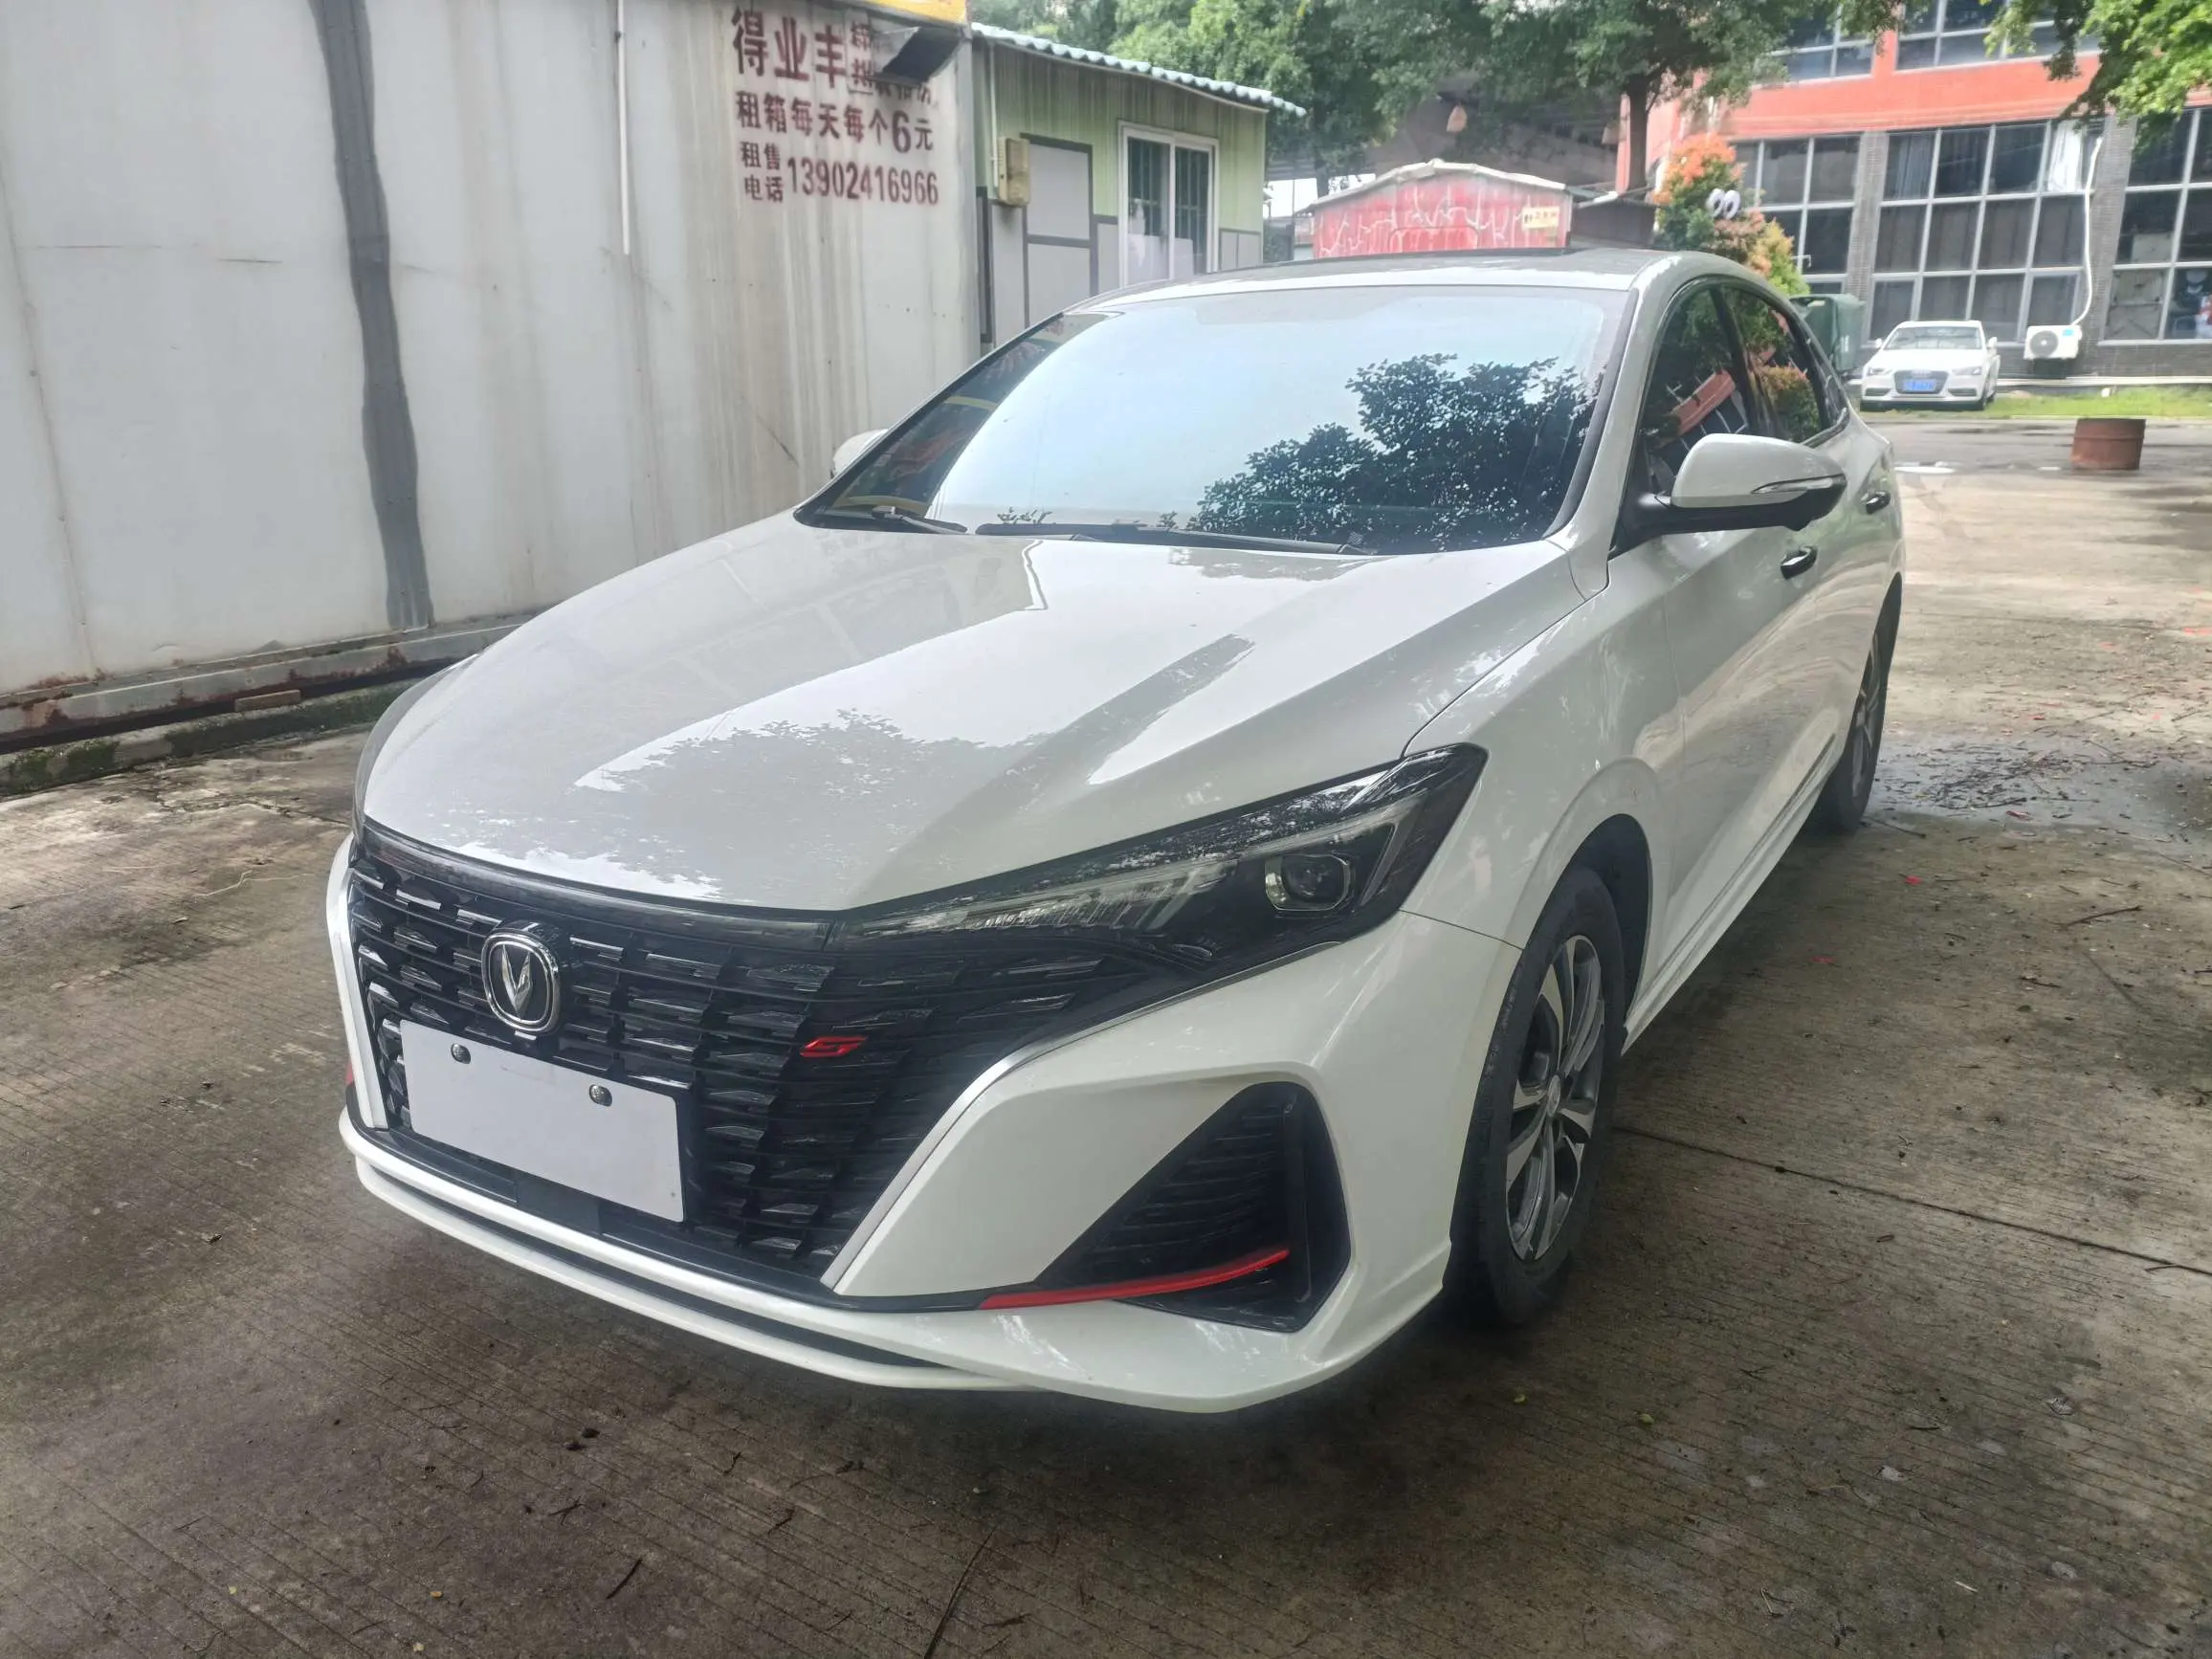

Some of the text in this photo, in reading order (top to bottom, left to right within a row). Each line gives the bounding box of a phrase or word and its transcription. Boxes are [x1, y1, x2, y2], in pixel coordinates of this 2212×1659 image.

[731, 6, 847, 88] 得业丰
[736, 90, 934, 153] 租箱每天每个6元
[741, 141, 782, 170] 租售
[743, 157, 939, 206] 电话 13902416966
